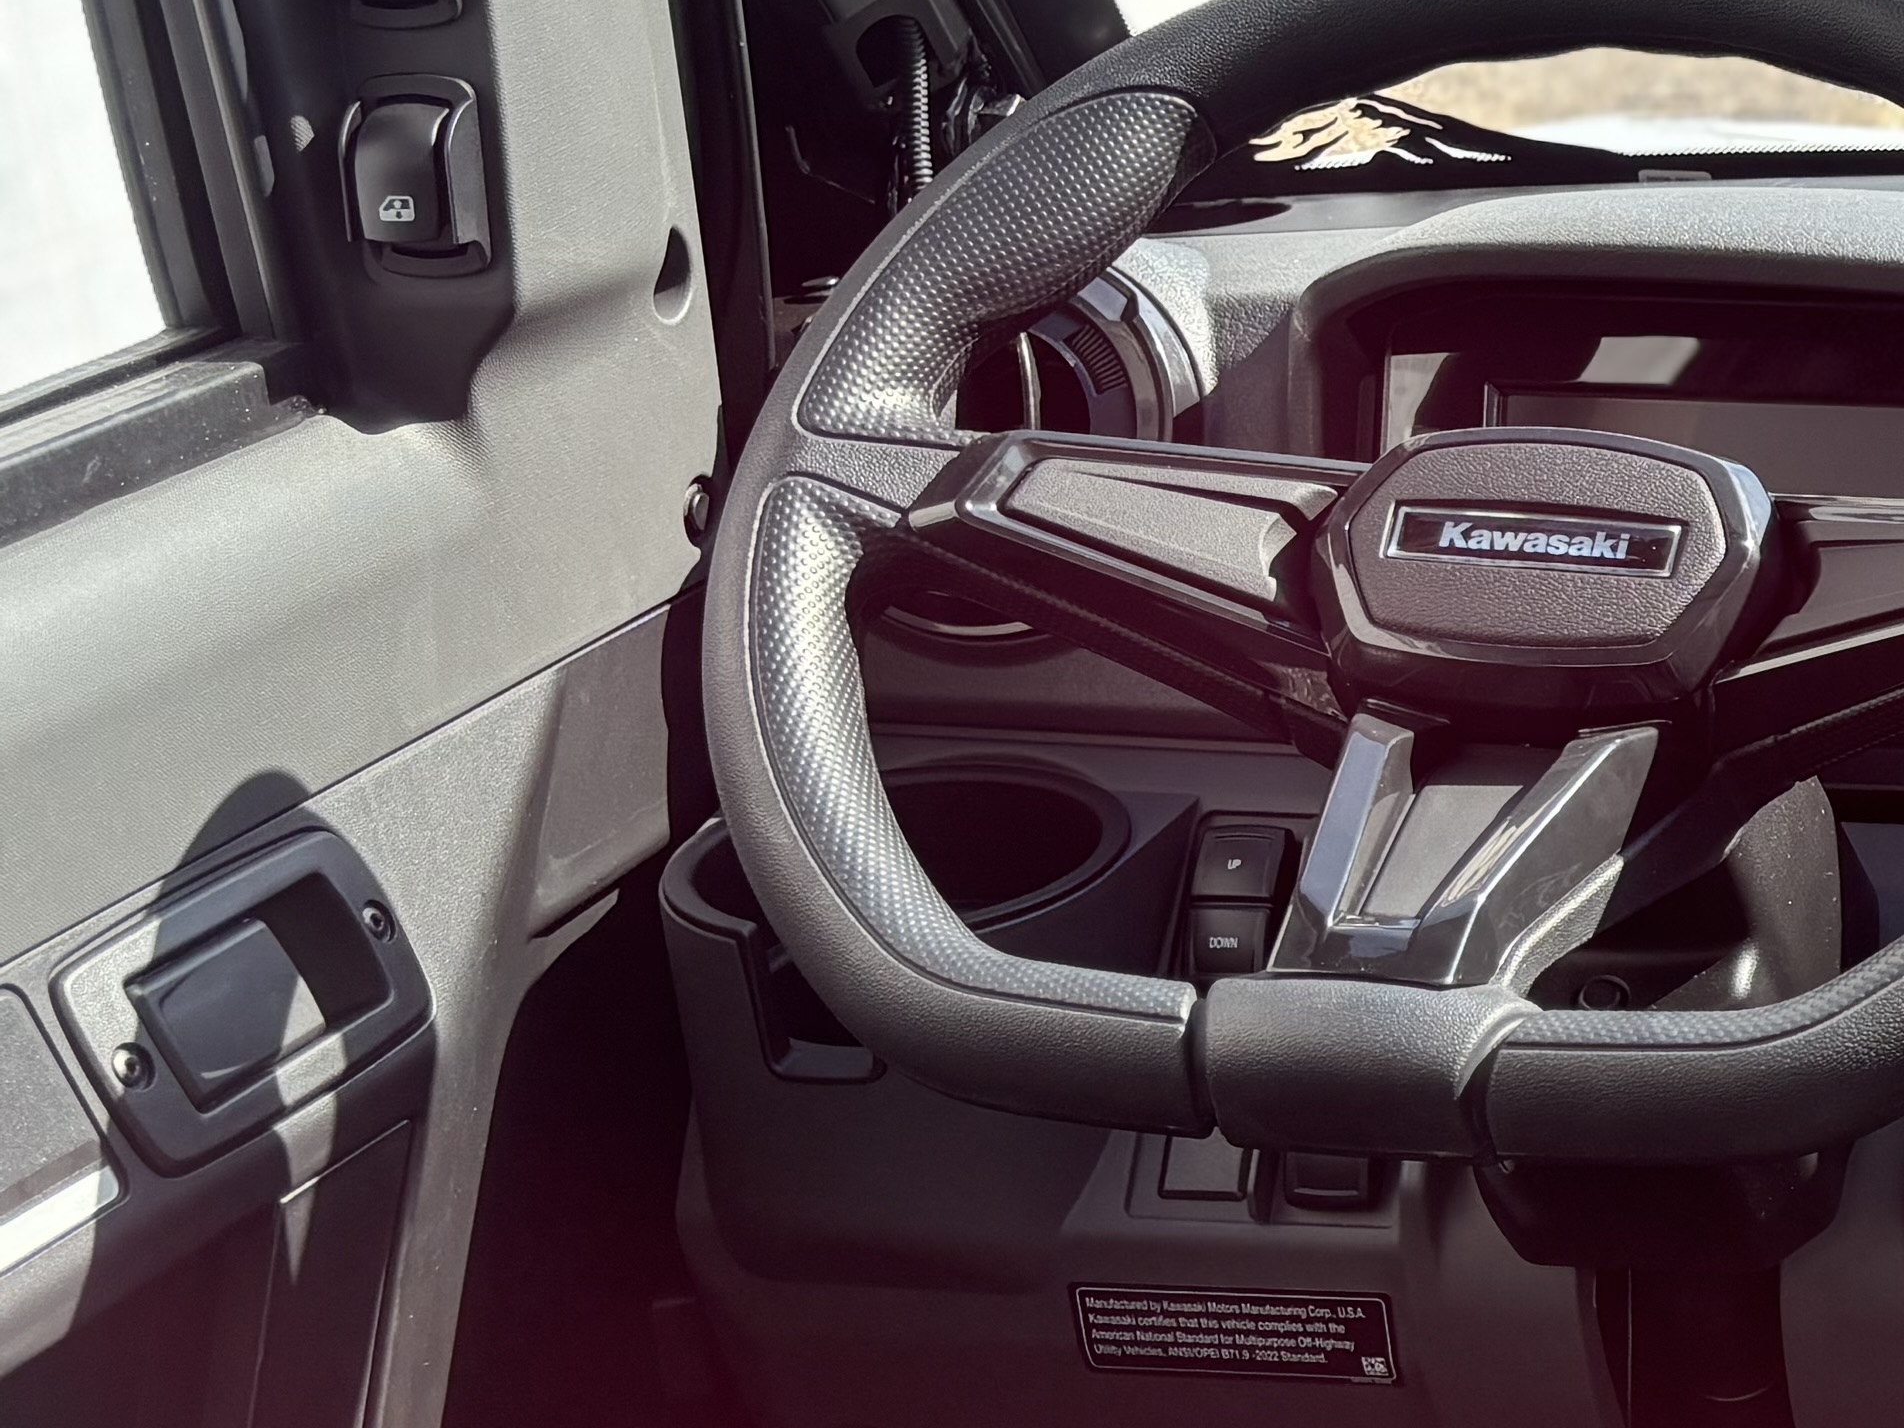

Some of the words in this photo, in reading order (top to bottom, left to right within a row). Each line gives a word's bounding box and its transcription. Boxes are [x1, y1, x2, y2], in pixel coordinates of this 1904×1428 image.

[1439, 521, 1629, 560] Kawasaki
[1227, 859, 1242, 870] UP
[1209, 937, 1238, 948] DOWN
